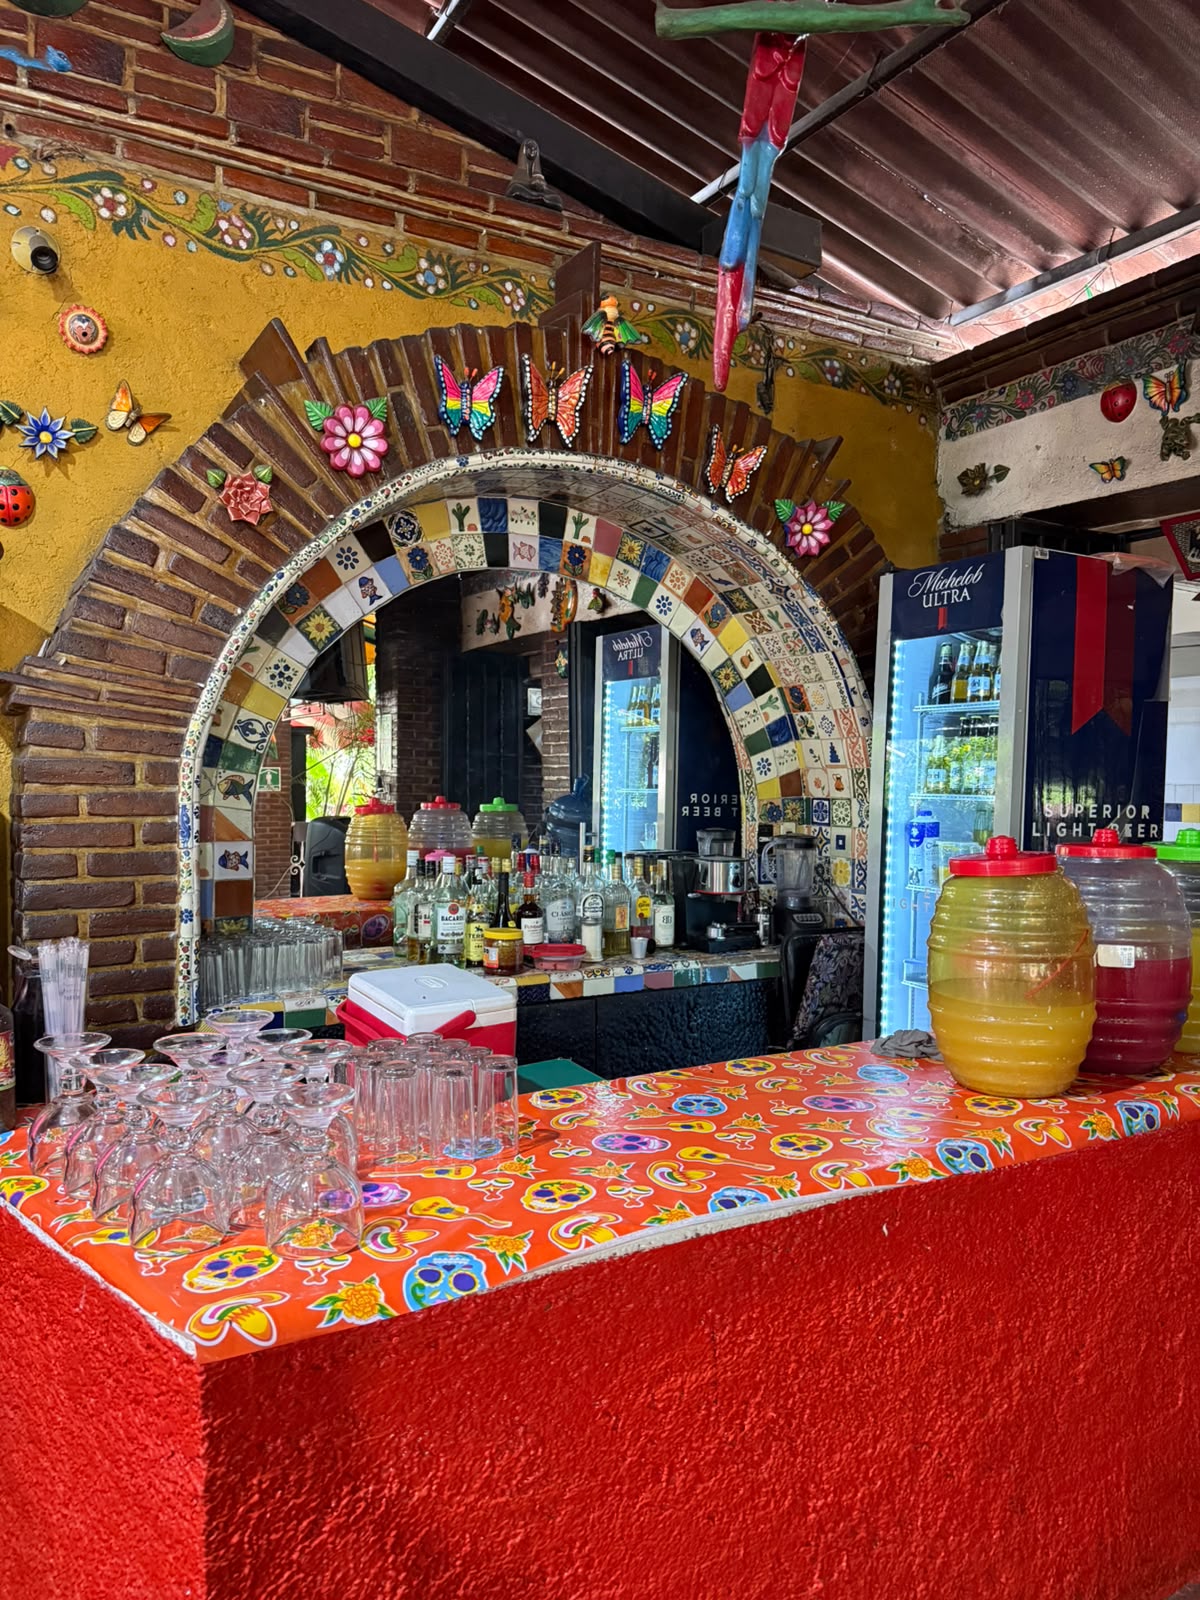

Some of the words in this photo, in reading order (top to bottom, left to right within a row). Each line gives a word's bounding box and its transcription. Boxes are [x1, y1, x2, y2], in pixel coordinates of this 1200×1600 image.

[908, 563, 985, 597] Michelob
[922, 587, 971, 608] ULTRA
[1044, 804, 1150, 819] SUPERIOR
[1032, 822, 1097, 837] LIGHT
